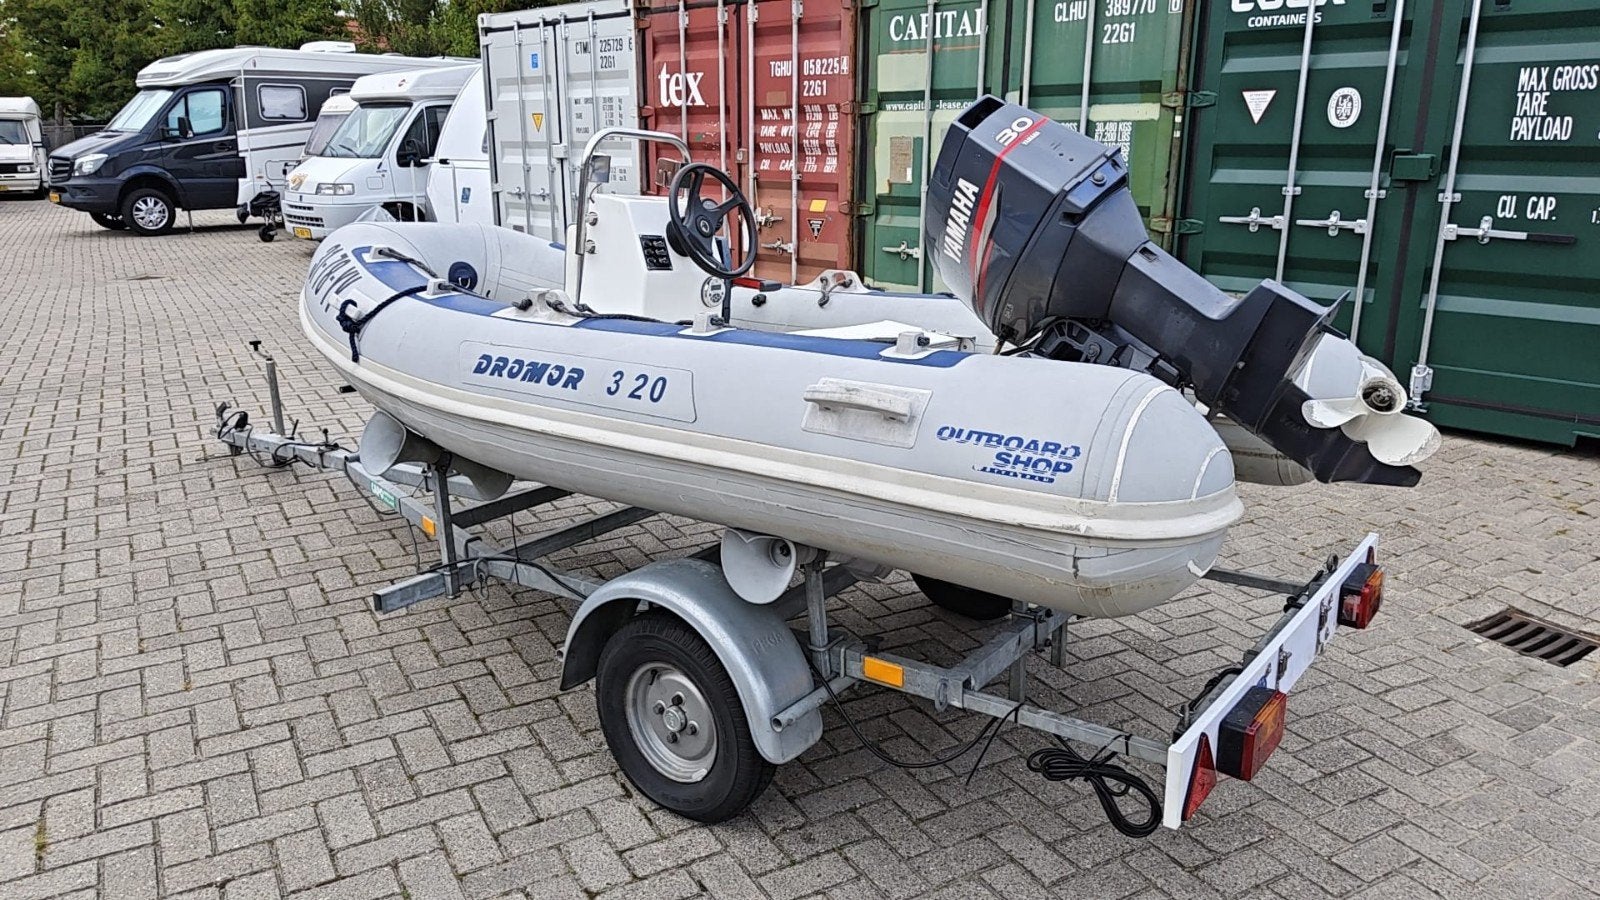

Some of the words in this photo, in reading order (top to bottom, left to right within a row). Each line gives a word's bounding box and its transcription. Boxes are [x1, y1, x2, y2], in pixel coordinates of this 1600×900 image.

[1054, 1, 1088, 22] CLHU
[1247, 12, 1323, 28] CONTAINES
[599, 37, 623, 53] 225729
[1102, 22, 1136, 44] 22G1
[600, 55, 616, 69] 22G1
[769, 60, 793, 77] TGHU
[658, 62, 706, 108] tex
[803, 79, 827, 97] 22G1
[1517, 66, 1549, 92] MAX
[1552, 64, 1600, 91] GROSS
[1515, 91, 1550, 117] TARE
[995, 116, 1034, 147] 30
[1510, 116, 1573, 141] PAYLOAD
[759, 142, 791, 154] PAYLOAD
[1496, 195, 1518, 219] CU.
[1526, 196, 1557, 221] CAP.
[943, 177, 980, 265] YAMAHA
[472, 353, 586, 391] DROMOR
[936, 426, 1082, 461] OUTBOARD
[992, 451, 1074, 477] SHOP
